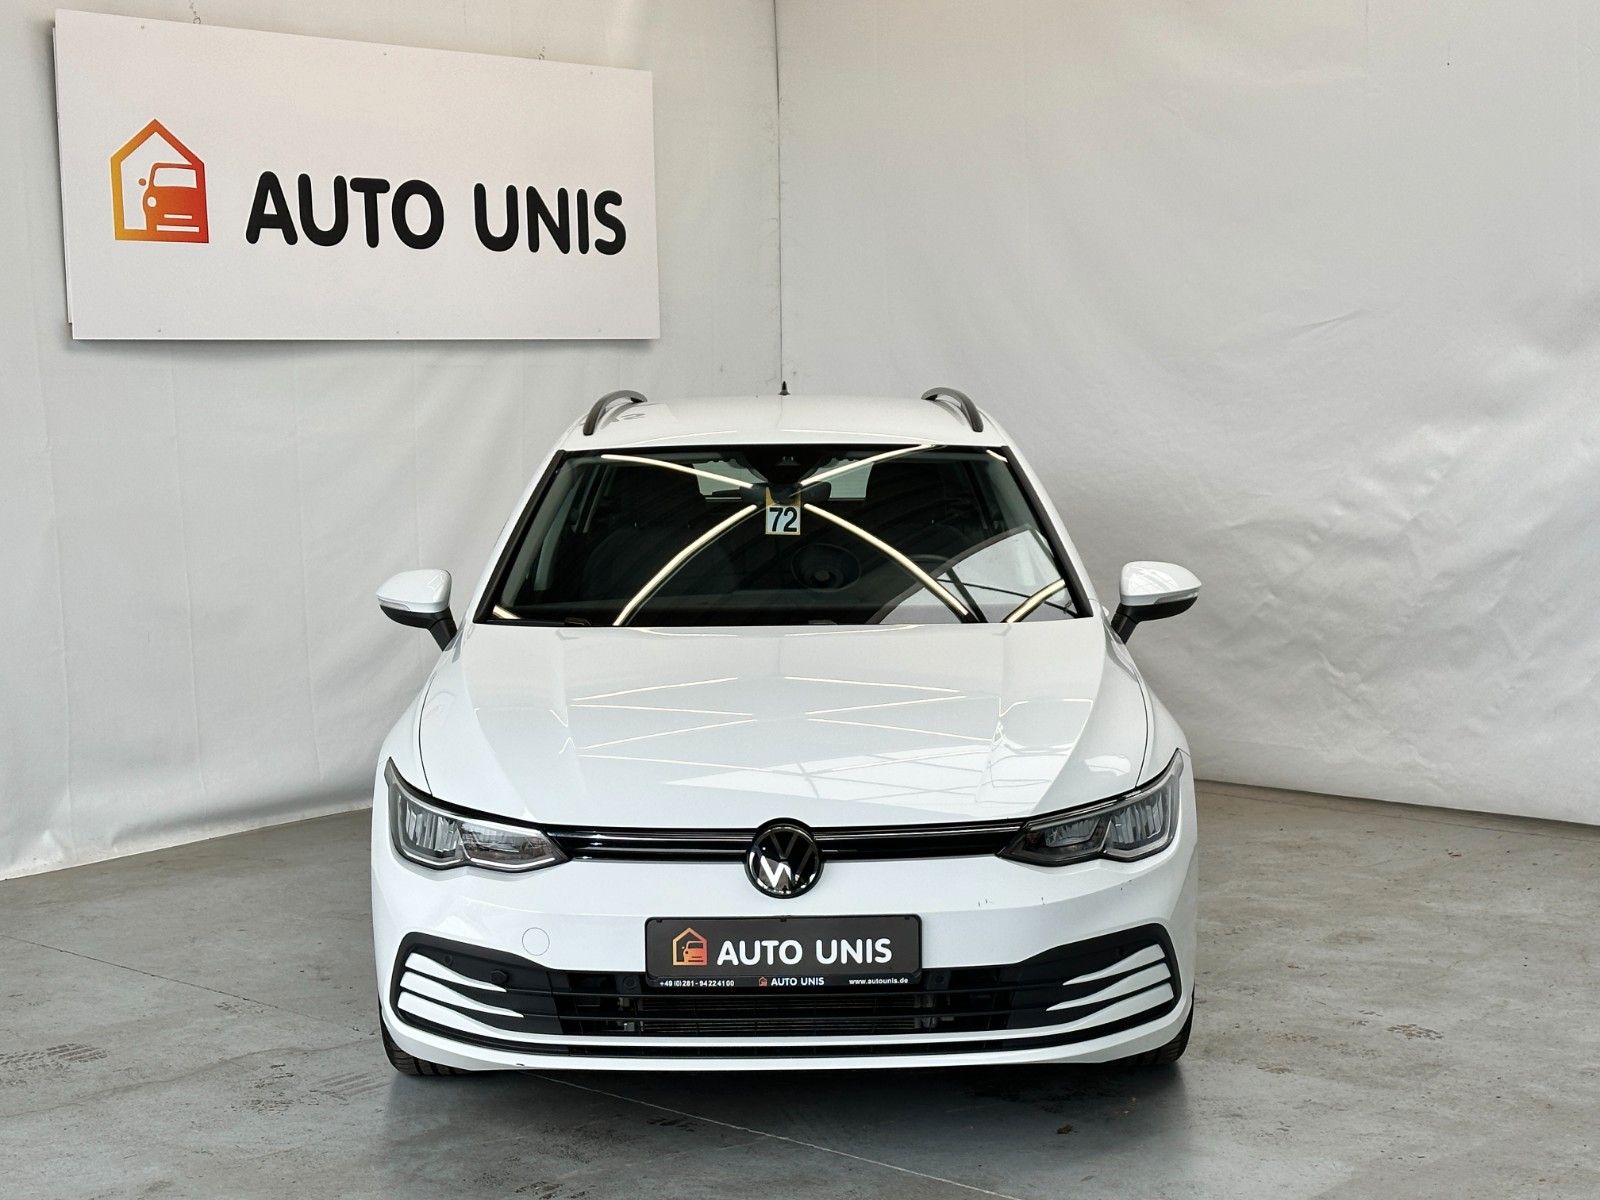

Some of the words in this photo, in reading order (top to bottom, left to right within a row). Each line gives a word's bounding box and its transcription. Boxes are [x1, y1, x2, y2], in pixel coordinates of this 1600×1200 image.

[245, 170, 445, 250] AUTO
[473, 182, 627, 256] UNIS
[769, 506, 798, 532] 72
[716, 939, 803, 966] AUTO
[815, 937, 893, 965] UNIS
[770, 977, 798, 986] AUTO
[800, 976, 825, 986] UNIS
[848, 977, 909, 985] www.autounis.de
